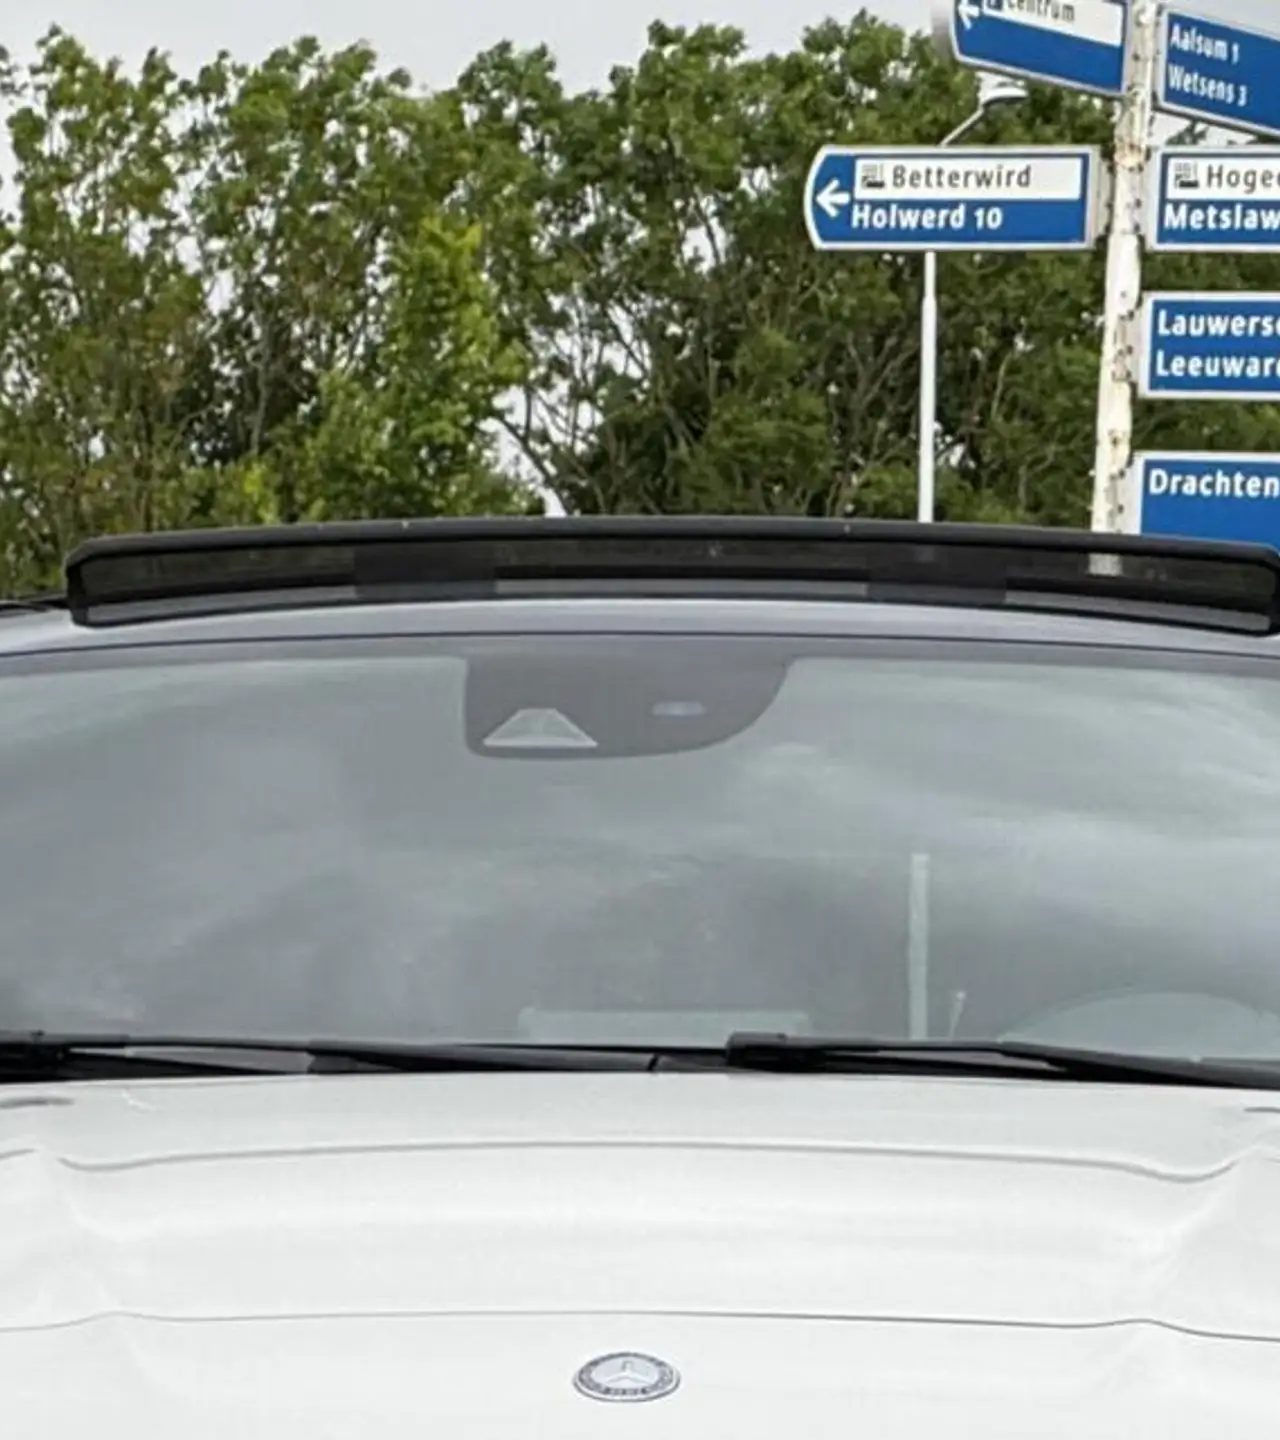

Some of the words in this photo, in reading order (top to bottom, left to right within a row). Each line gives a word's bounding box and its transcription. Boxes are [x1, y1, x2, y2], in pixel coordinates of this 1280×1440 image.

[1170, 23, 1228, 61] Aalsum
[1231, 43, 1240, 64] 1
[1169, 64, 1235, 104] Wetsens
[1237, 85, 1248, 107] 3
[892, 165, 1032, 189] Betterwird
[851, 204, 966, 230] Holwerd
[974, 207, 1003, 229] 10
[1149, 468, 1280, 498] Drachten
